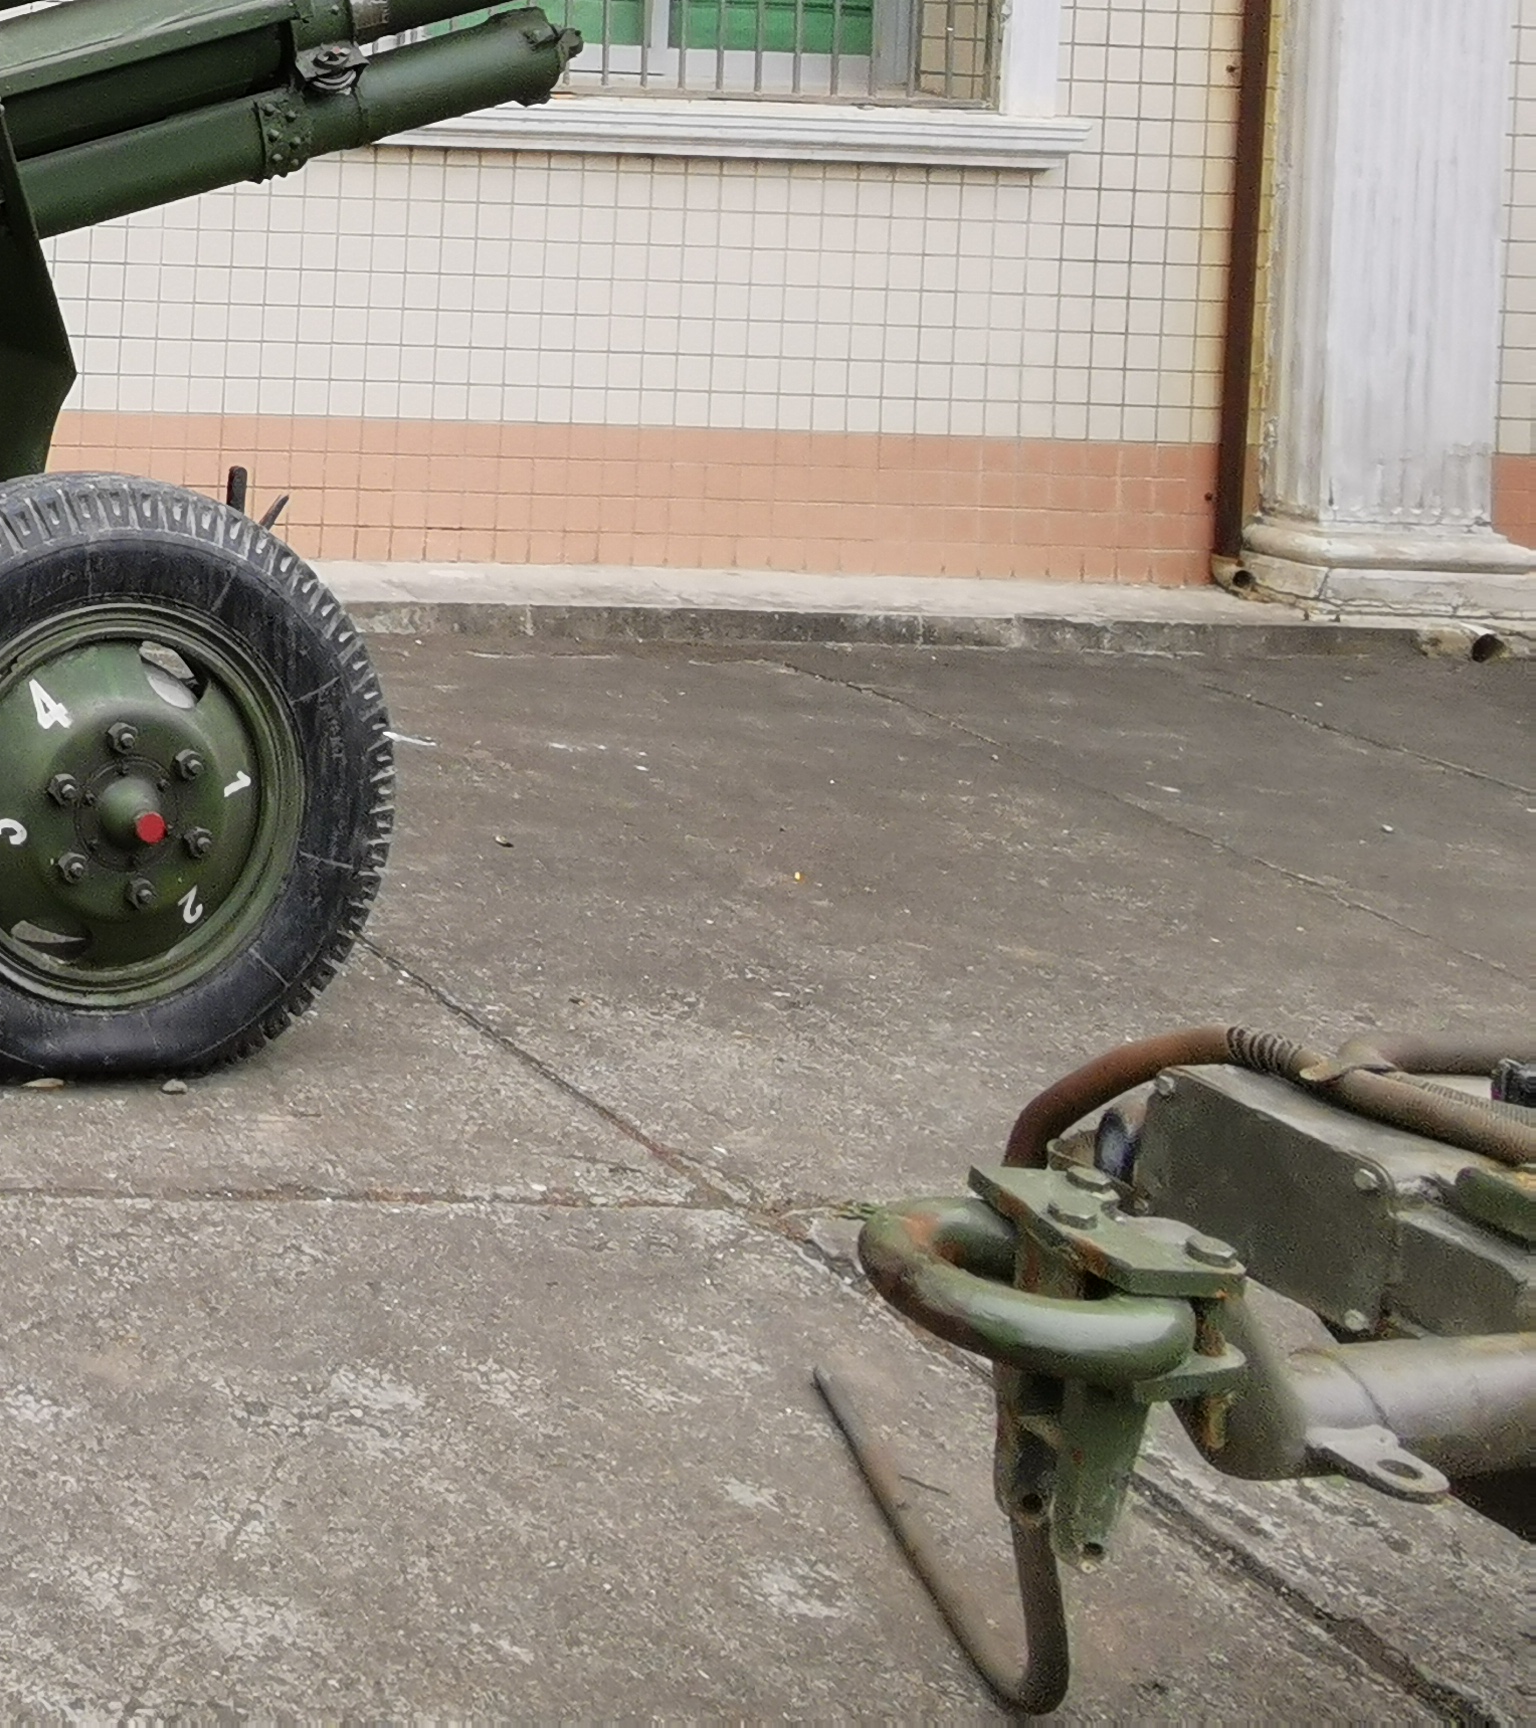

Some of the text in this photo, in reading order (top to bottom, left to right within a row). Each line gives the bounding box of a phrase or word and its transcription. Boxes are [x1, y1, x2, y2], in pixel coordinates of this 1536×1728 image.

[29, 678, 74, 729] 4
[224, 770, 252, 798] 1
[178, 885, 204, 924] 2
